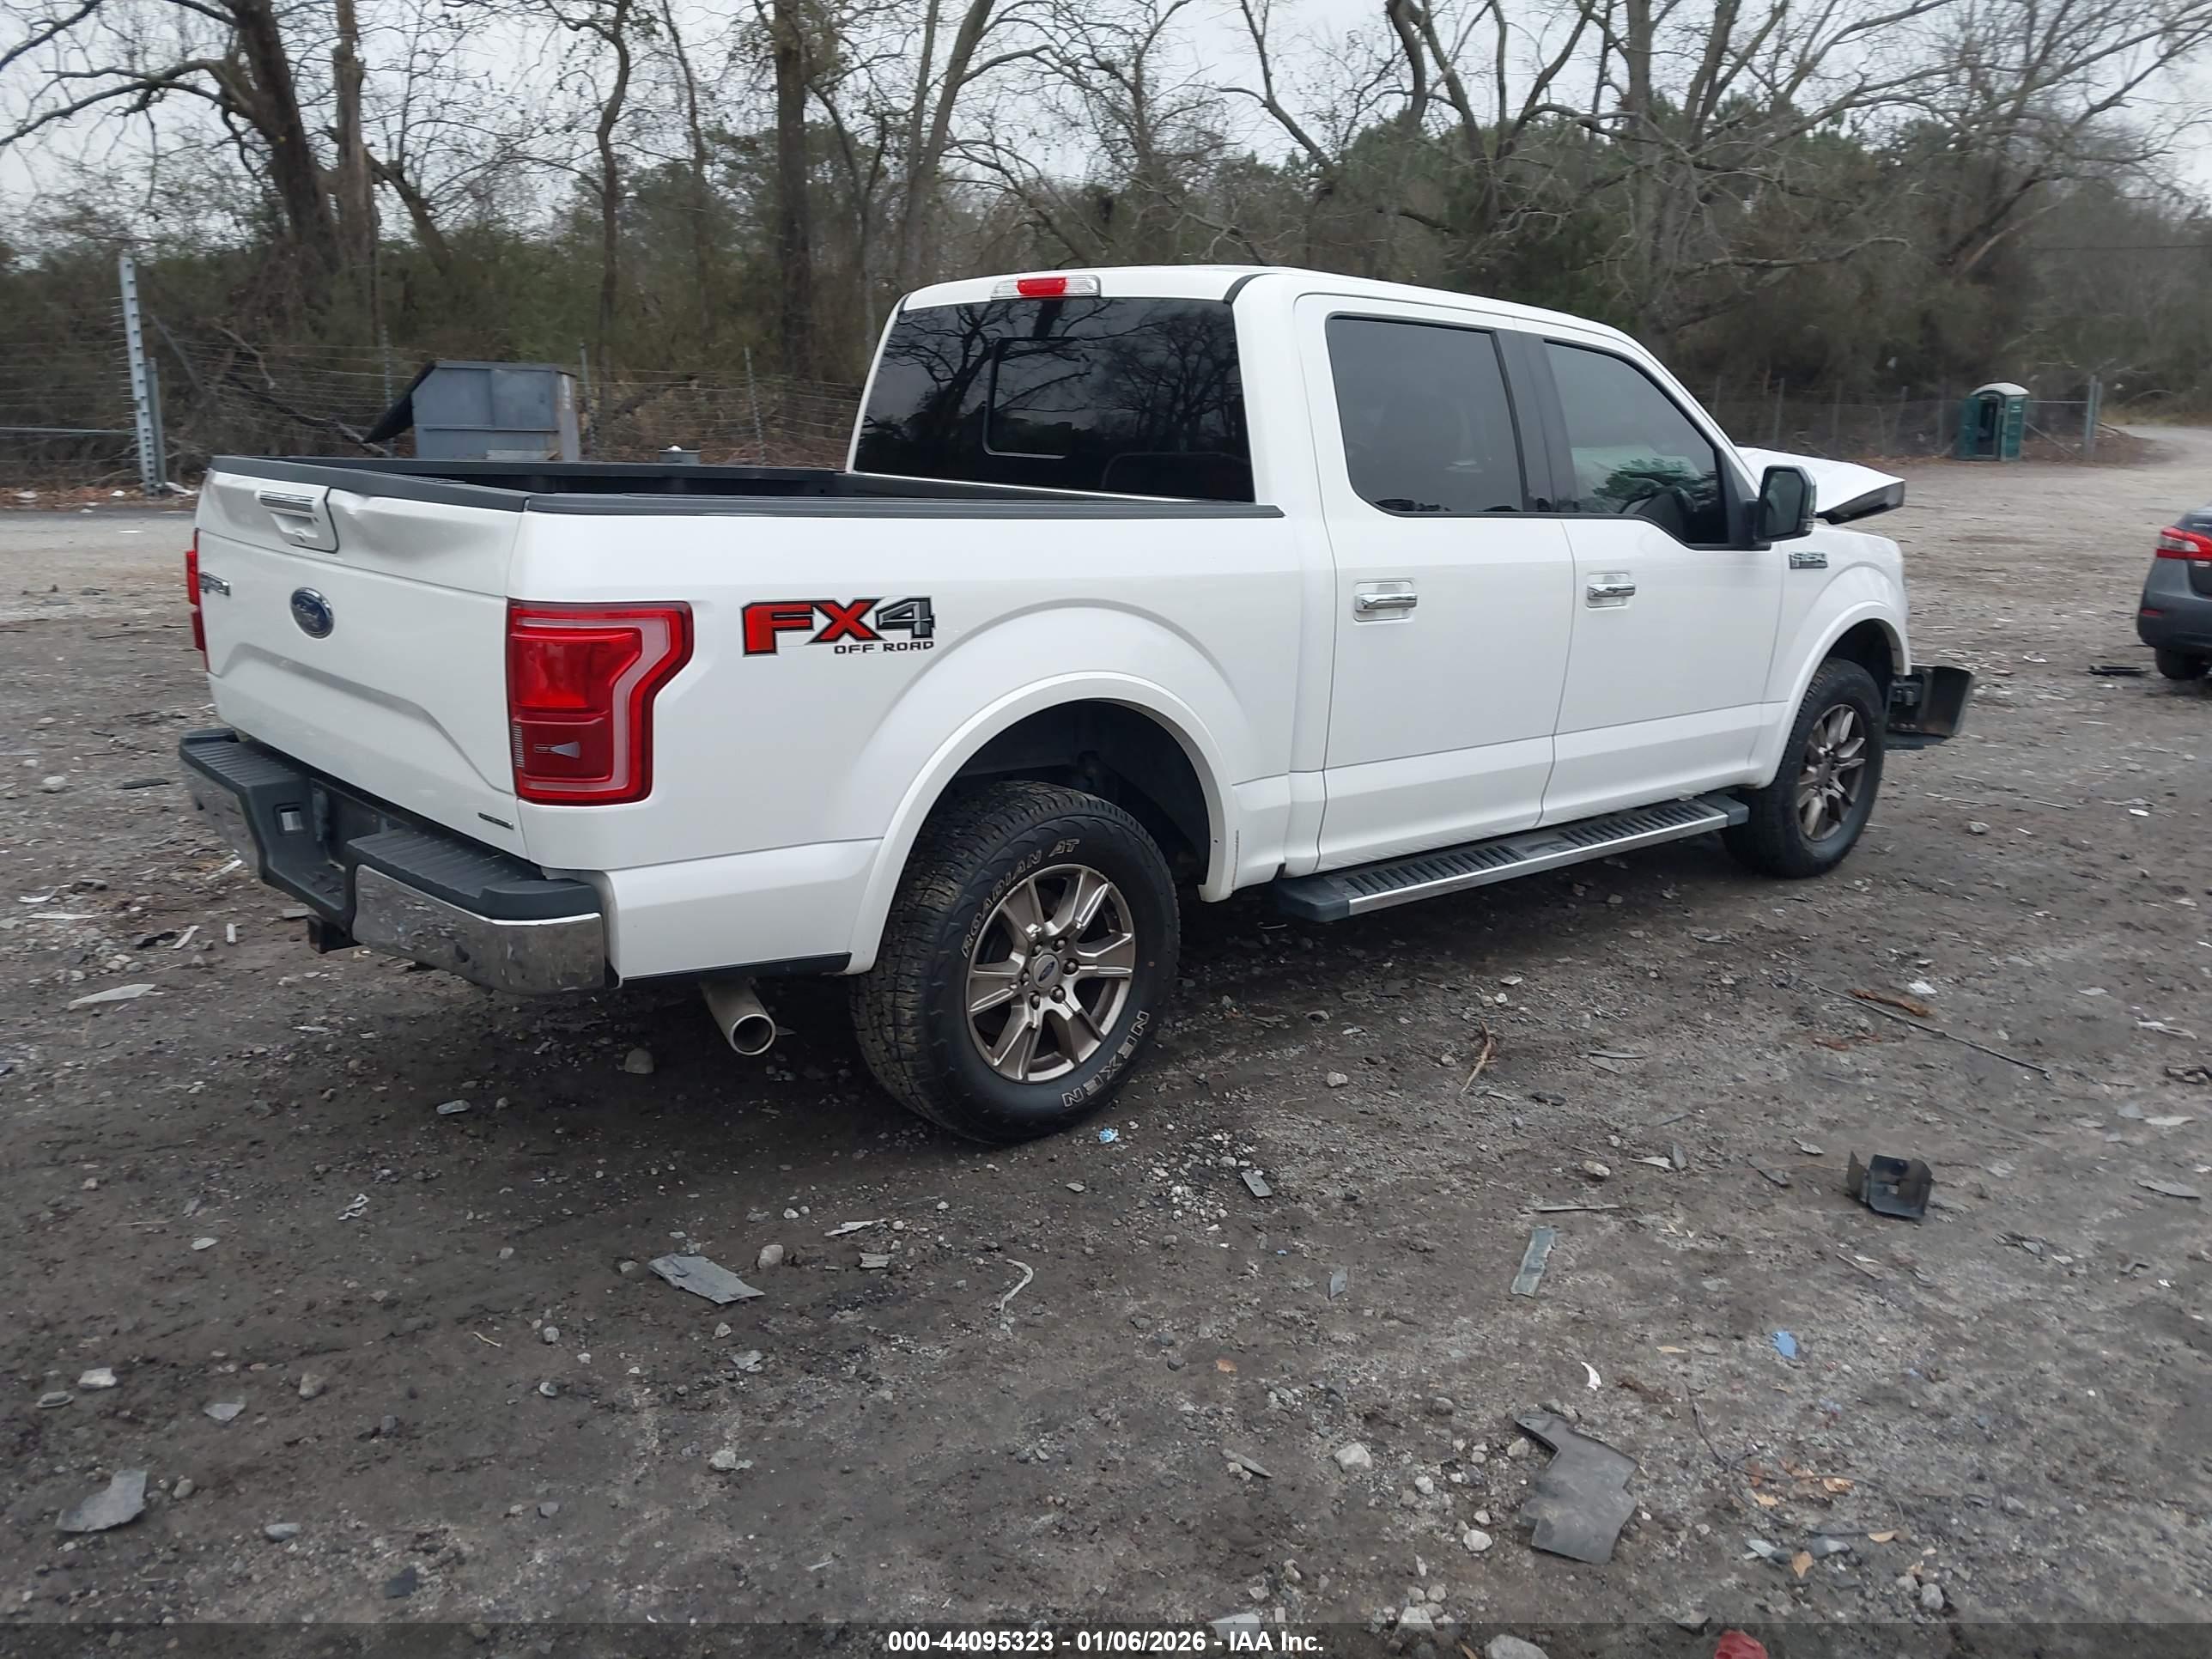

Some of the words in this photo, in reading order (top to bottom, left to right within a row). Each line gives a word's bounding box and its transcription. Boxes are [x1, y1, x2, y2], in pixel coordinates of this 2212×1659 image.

[741, 597, 935, 656] FX4
[834, 644, 875, 654] OFF
[883, 641, 934, 652] ROAD
[1048, 838, 1080, 857] AT
[1061, 1010, 1150, 1107] NEXEN
